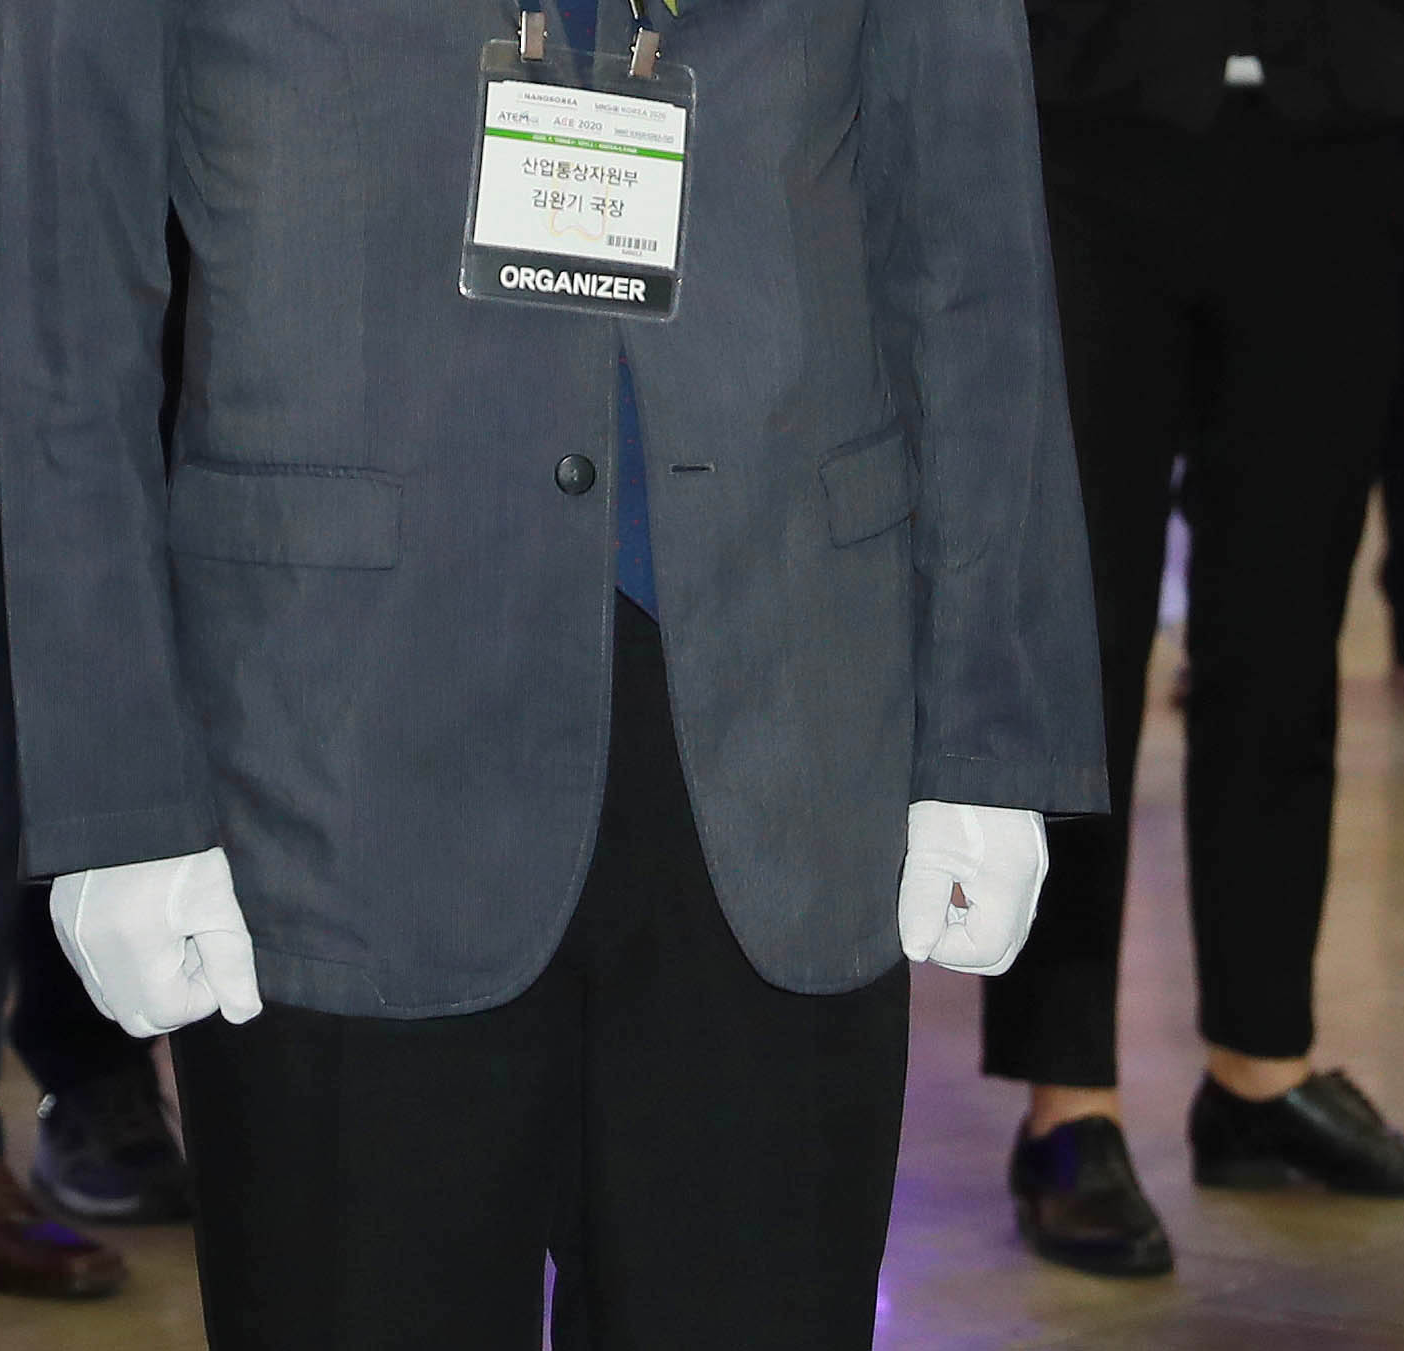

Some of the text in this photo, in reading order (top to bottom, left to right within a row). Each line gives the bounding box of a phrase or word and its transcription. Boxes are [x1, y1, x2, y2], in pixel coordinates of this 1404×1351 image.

[522, 157, 638, 188] 산업통상자원부
[532, 189, 625, 218] 김완기 국장
[499, 264, 646, 302] ORGANIZER
